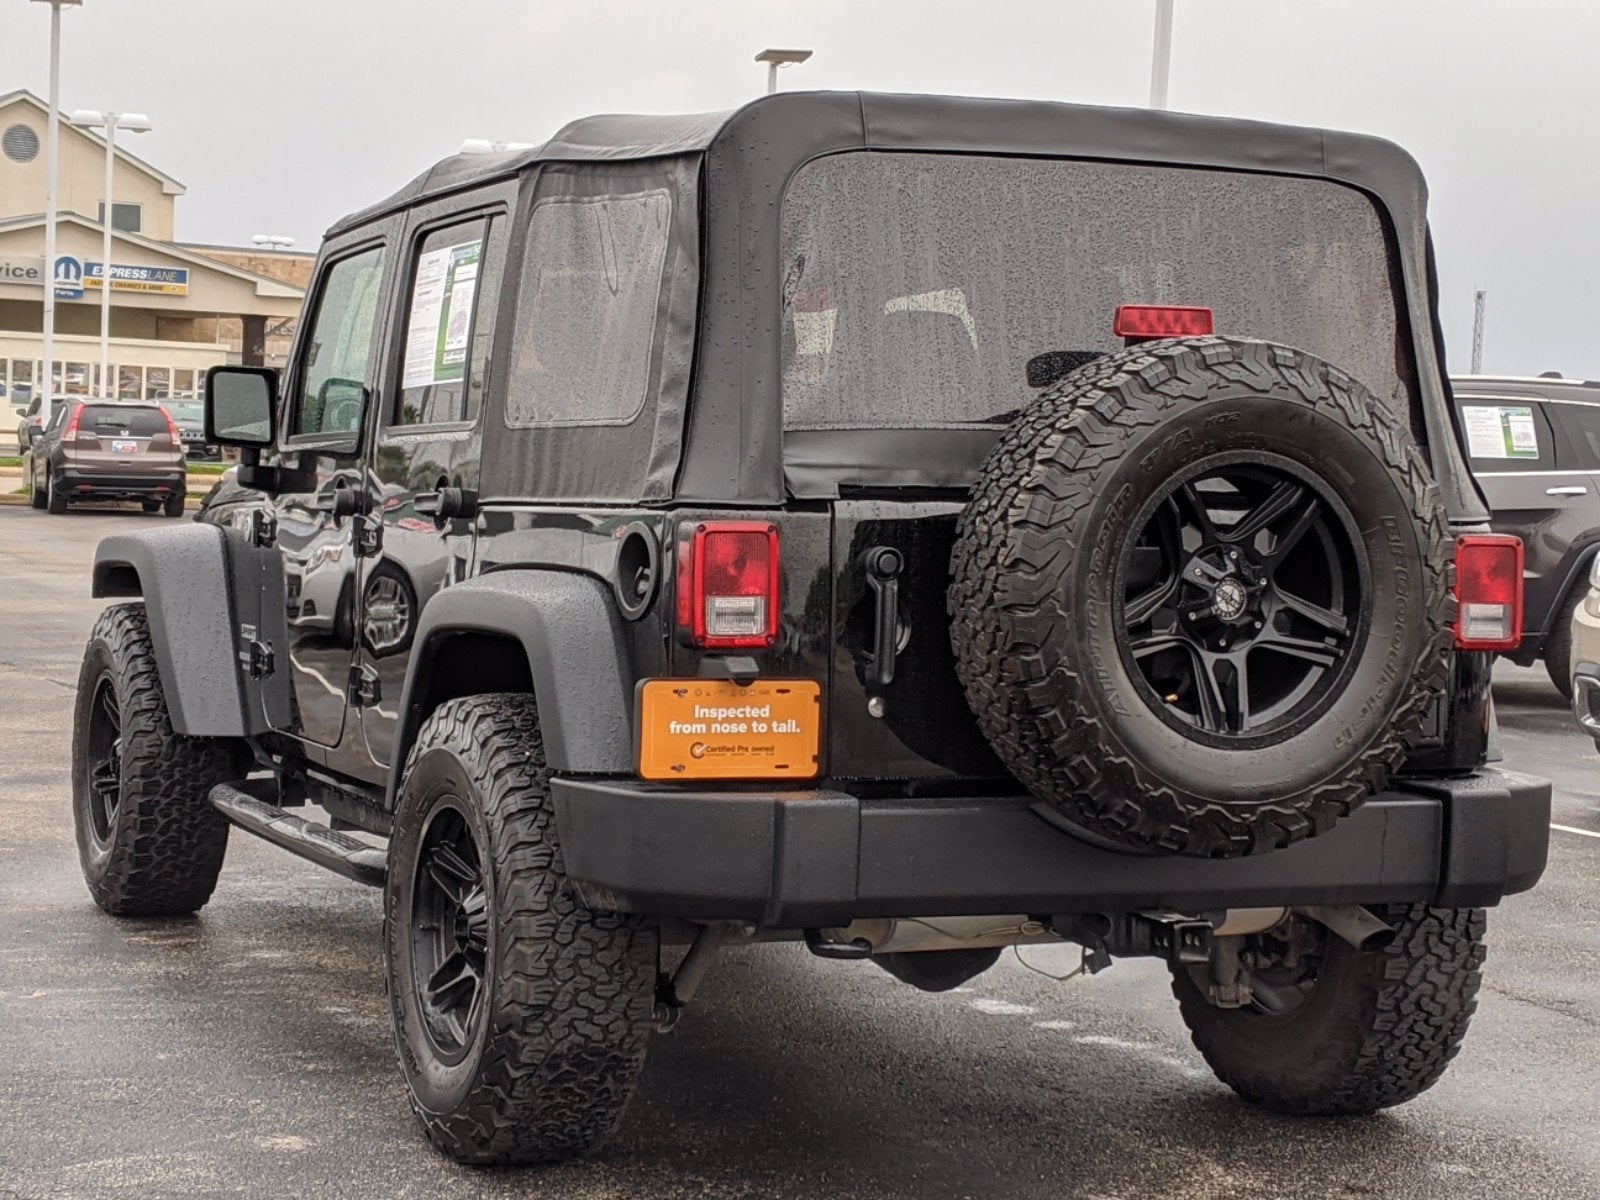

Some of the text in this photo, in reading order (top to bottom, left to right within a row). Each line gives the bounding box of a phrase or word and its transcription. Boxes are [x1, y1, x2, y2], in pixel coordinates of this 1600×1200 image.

[694, 704, 770, 721] Inspected
[669, 720, 801, 734] from nose to tail.
